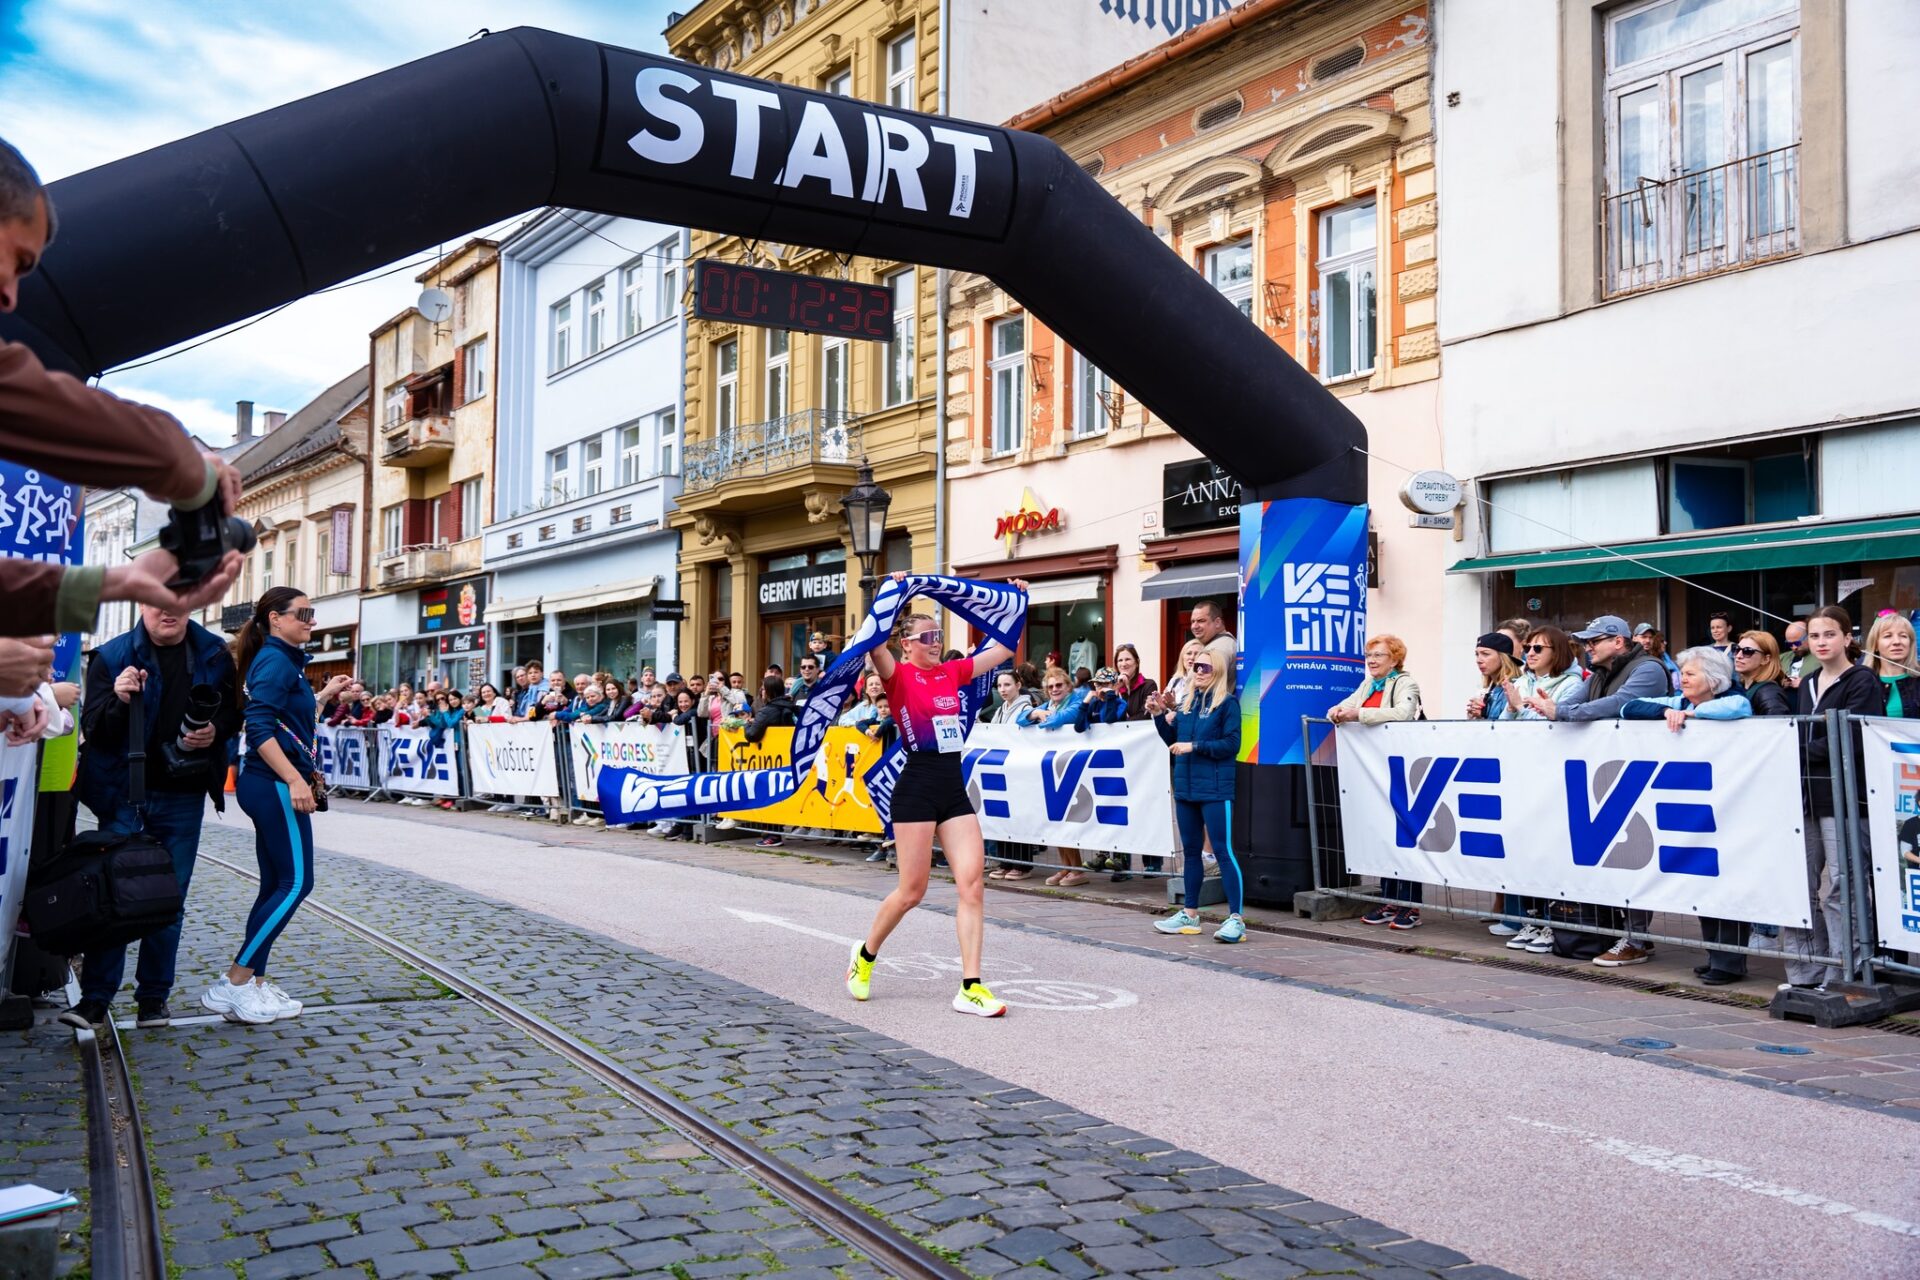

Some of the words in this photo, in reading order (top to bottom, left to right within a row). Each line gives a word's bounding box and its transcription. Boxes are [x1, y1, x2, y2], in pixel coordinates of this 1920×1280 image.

[627, 67, 993, 219] START
[702, 267, 889, 335] 00:12:32
[994, 507, 1059, 540] MÓDA
[1433, 517, 1450, 525] SHOP
[760, 578, 800, 604] GERRY
[801, 573, 848, 599] WEBER
[1286, 662, 1327, 670] VYHRÁVA
[942, 727, 958, 739] 178
[495, 740, 535, 772] KOŠICE
[601, 742, 655, 762] PROGRESS
